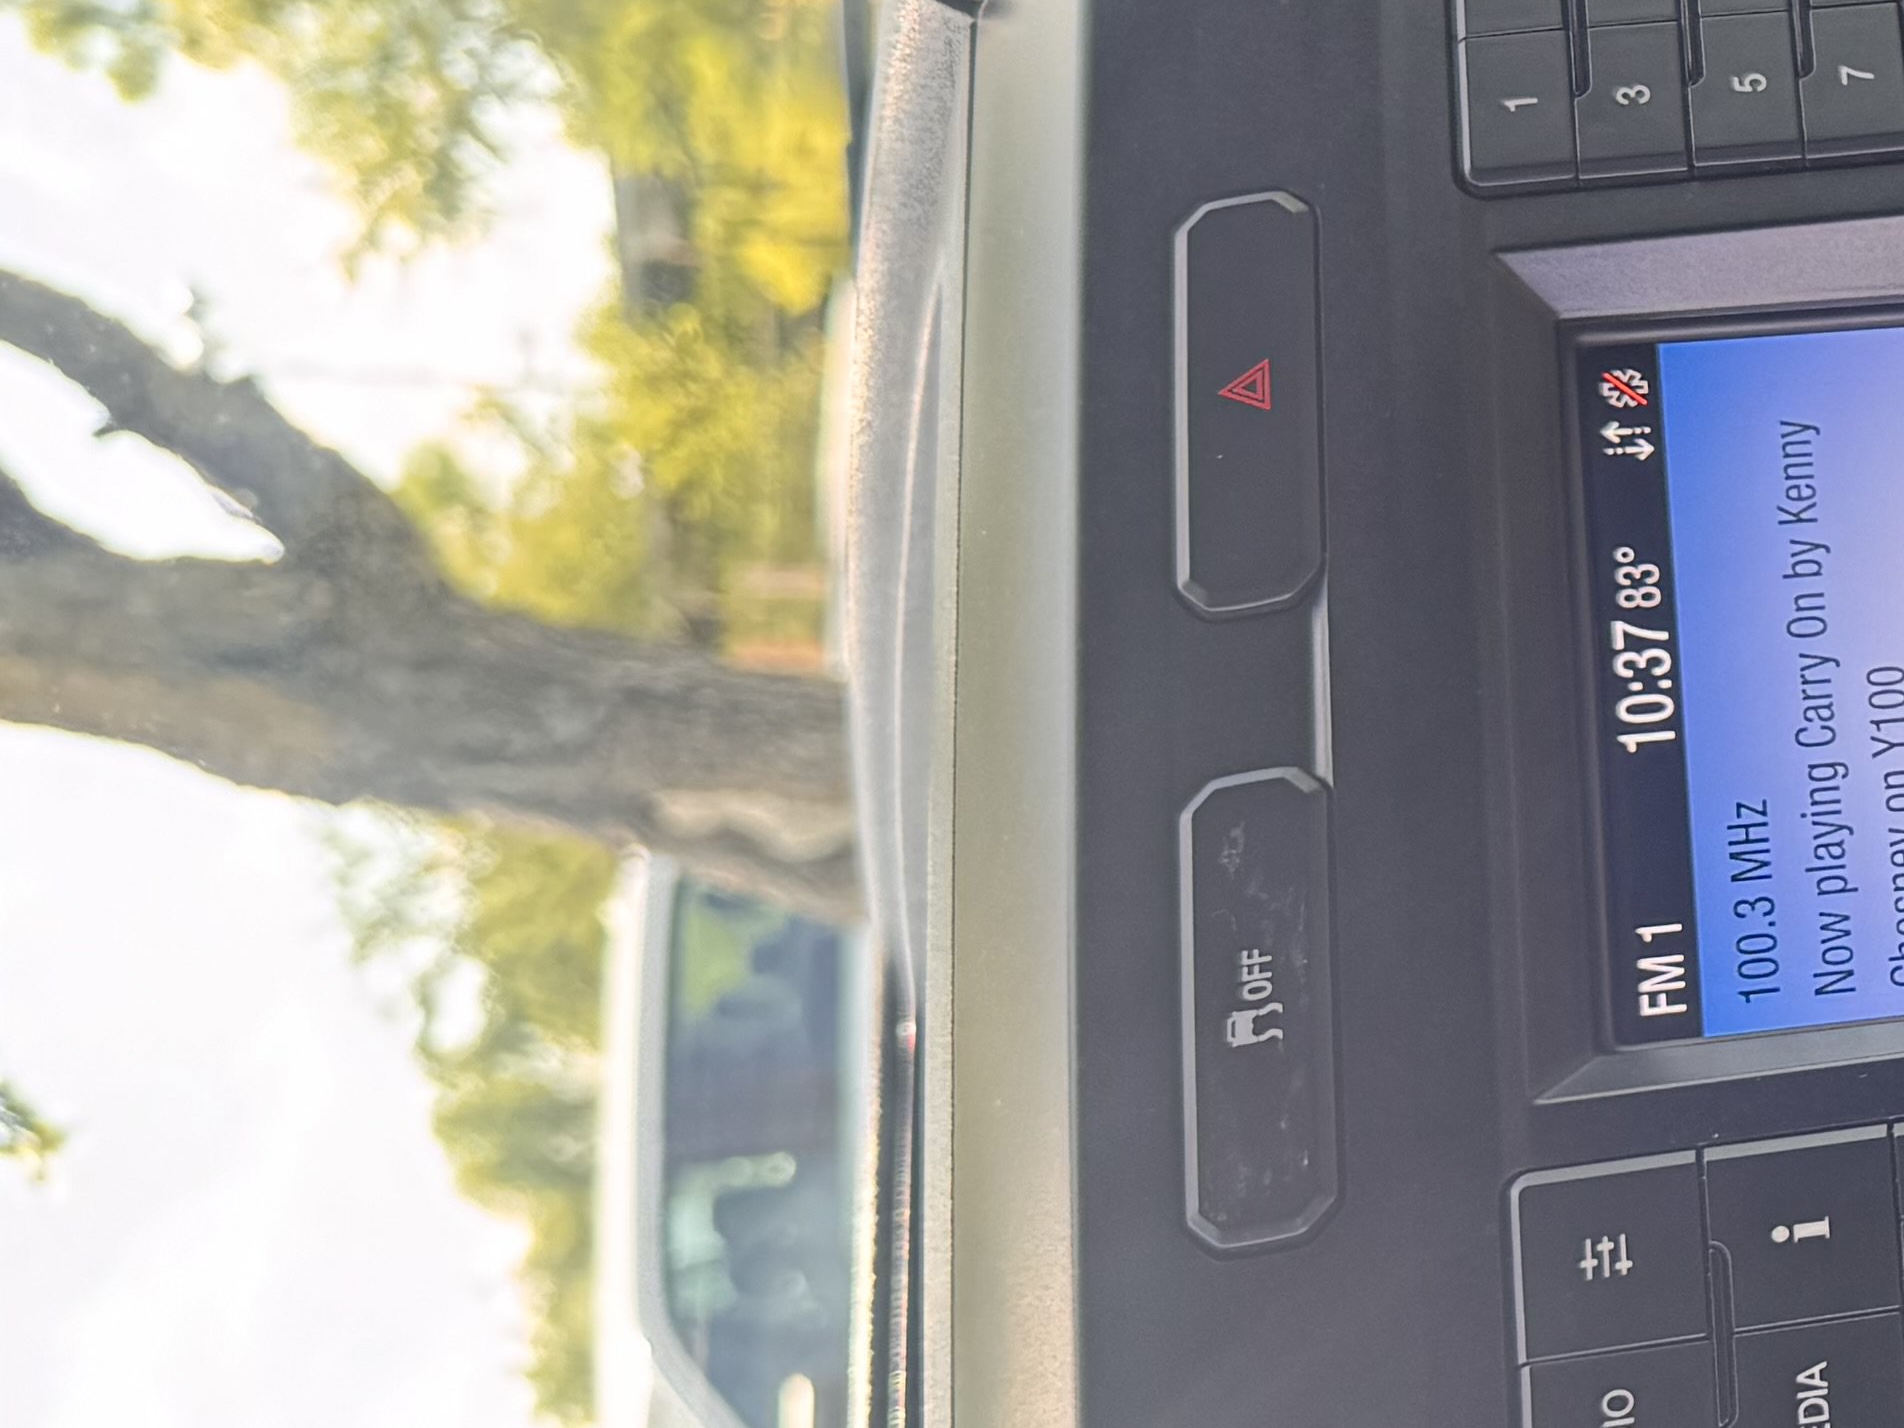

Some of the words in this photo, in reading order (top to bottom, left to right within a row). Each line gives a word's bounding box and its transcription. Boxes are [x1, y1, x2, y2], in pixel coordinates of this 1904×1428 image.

[1615, 84, 1651, 105] 3
[1732, 73, 1767, 93] 5
[1839, 65, 1875, 86] 7
[1503, 97, 1538, 112] 1
[1776, 420, 1821, 526] Kenny
[1782, 539, 1831, 580] by
[1786, 592, 1828, 639] On
[1611, 620, 1677, 753] 10:37
[1794, 652, 1841, 748] Carry
[1726, 799, 1773, 883] MHz
[1800, 762, 1859, 896] playing
[1635, 923, 1683, 943] 1
[1733, 896, 1781, 1004] 100.3
[1812, 911, 1857, 996] Now
[1240, 948, 1273, 1000] OFF
[1636, 954, 1688, 1017] FM
